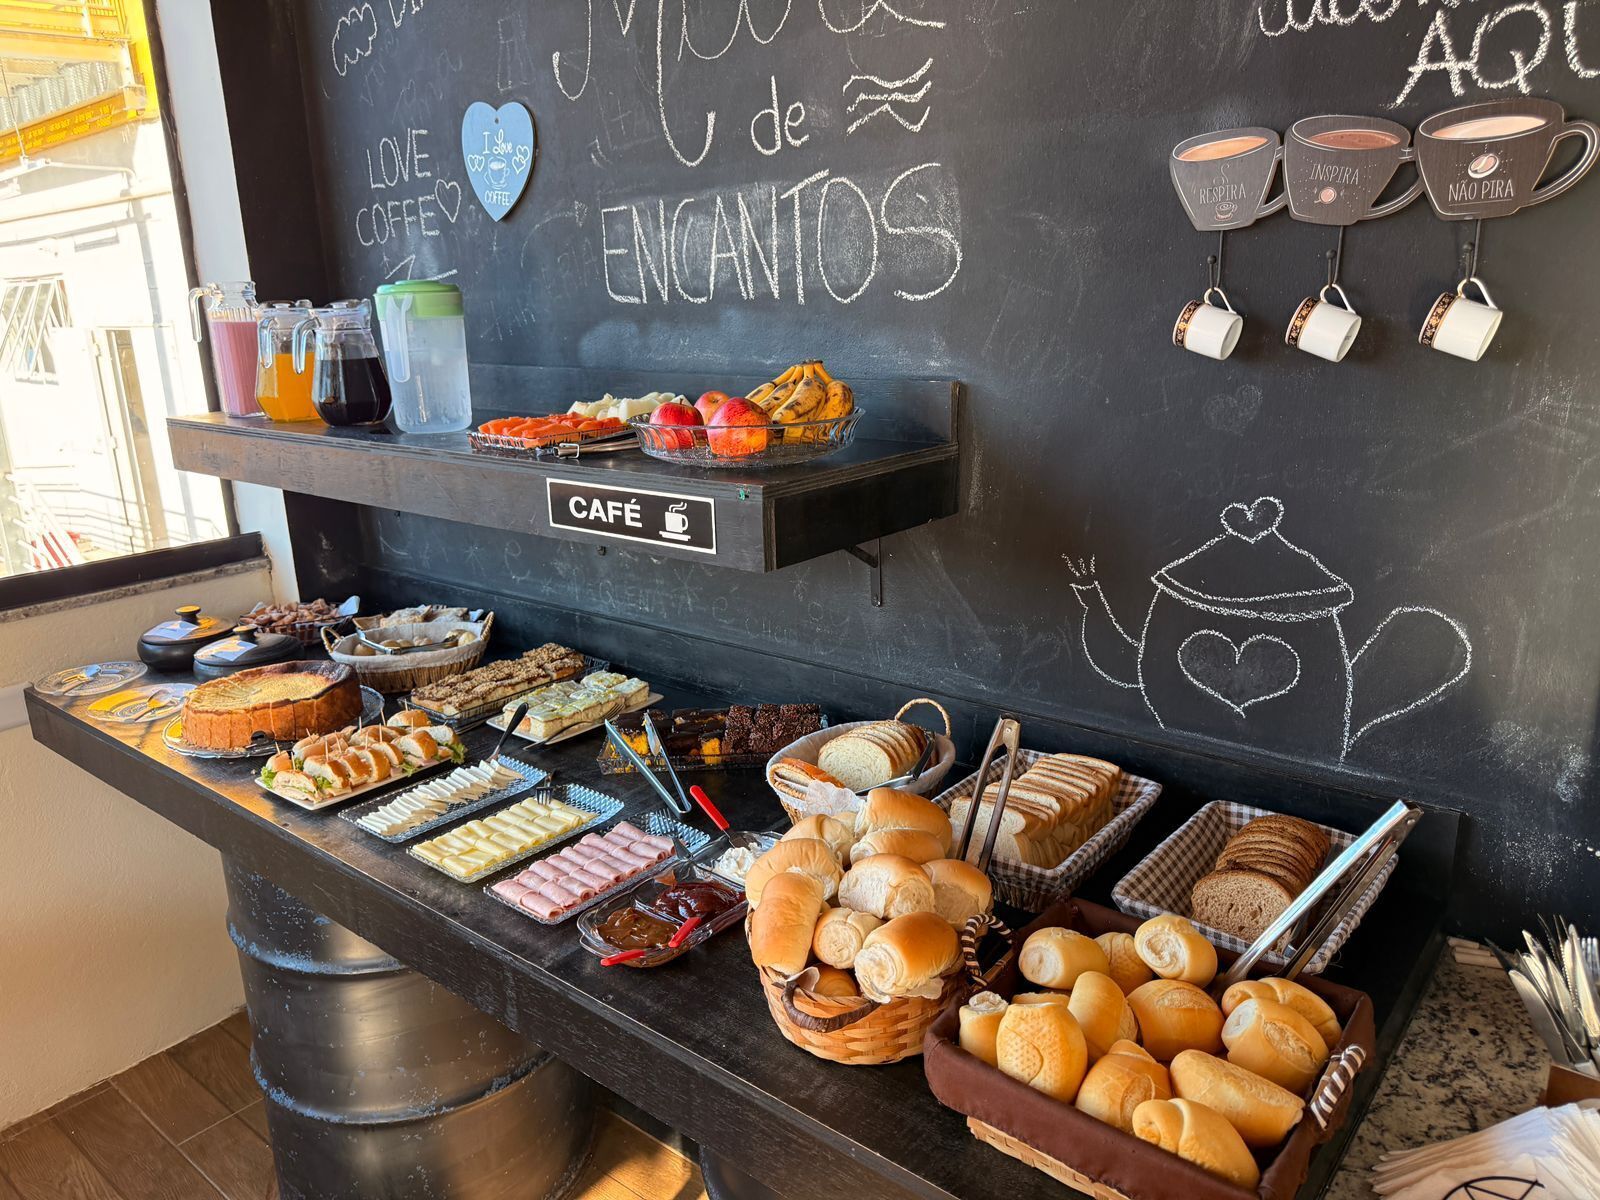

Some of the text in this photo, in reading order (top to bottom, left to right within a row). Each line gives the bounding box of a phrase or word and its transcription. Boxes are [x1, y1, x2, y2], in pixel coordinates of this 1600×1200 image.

[750, 75, 809, 155] de
[482, 128, 514, 155] I Love
[366, 128, 432, 189] LOVE
[1309, 163, 1359, 186] INSPIRA
[1199, 183, 1247, 205] RESPIRA
[1448, 179, 1514, 202] NÃO PIRA
[601, 162, 962, 305] ENCANTOS
[568, 496, 643, 528] CAFÉ
